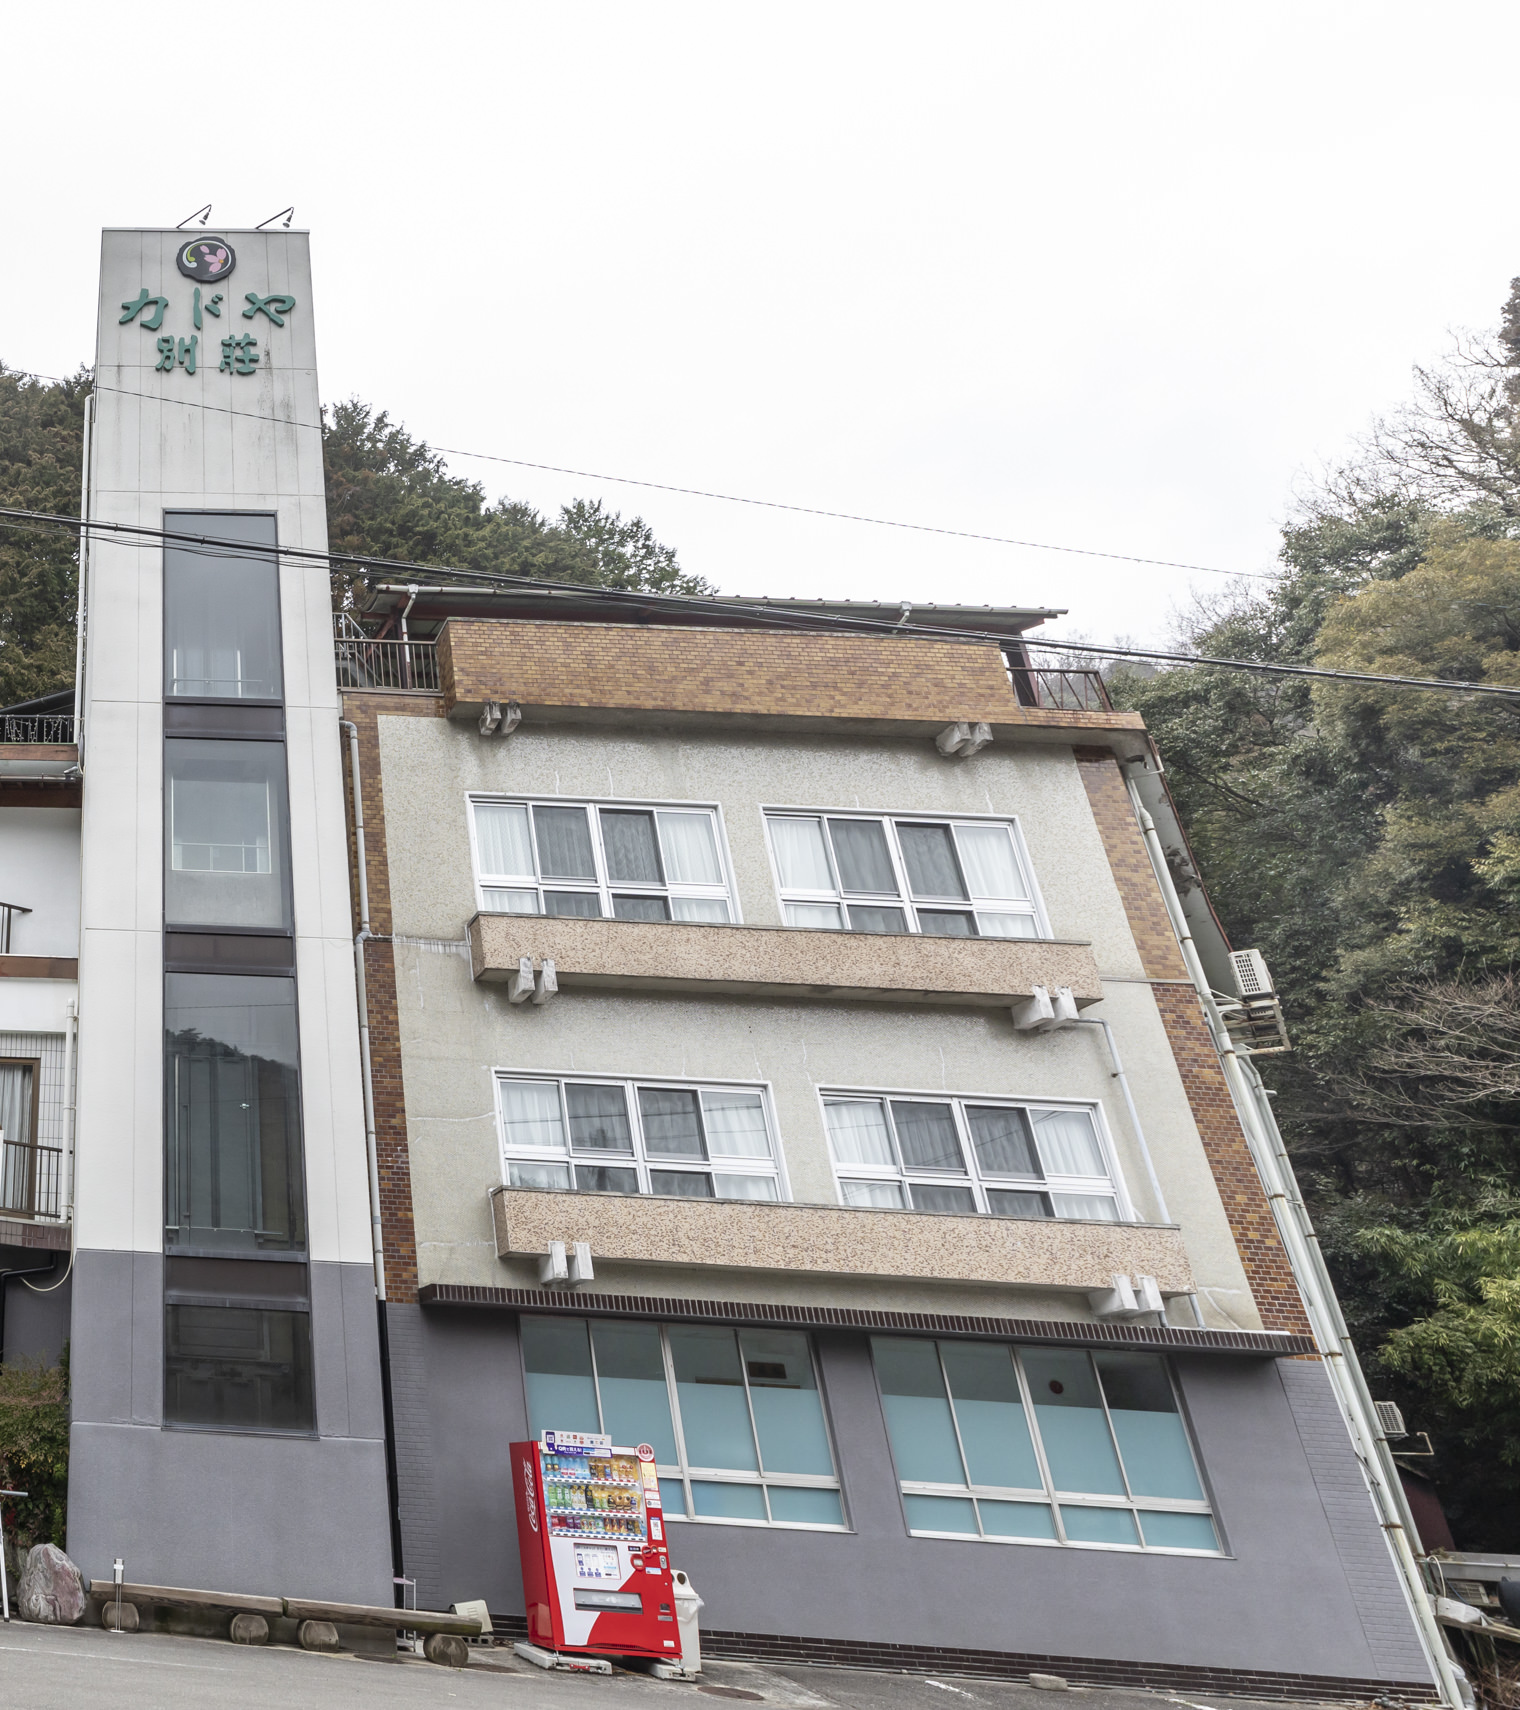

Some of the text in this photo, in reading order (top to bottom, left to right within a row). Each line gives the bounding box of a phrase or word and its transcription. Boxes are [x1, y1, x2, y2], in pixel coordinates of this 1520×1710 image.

[119, 287, 296, 331] カドや
[155, 333, 260, 375] 別荘
